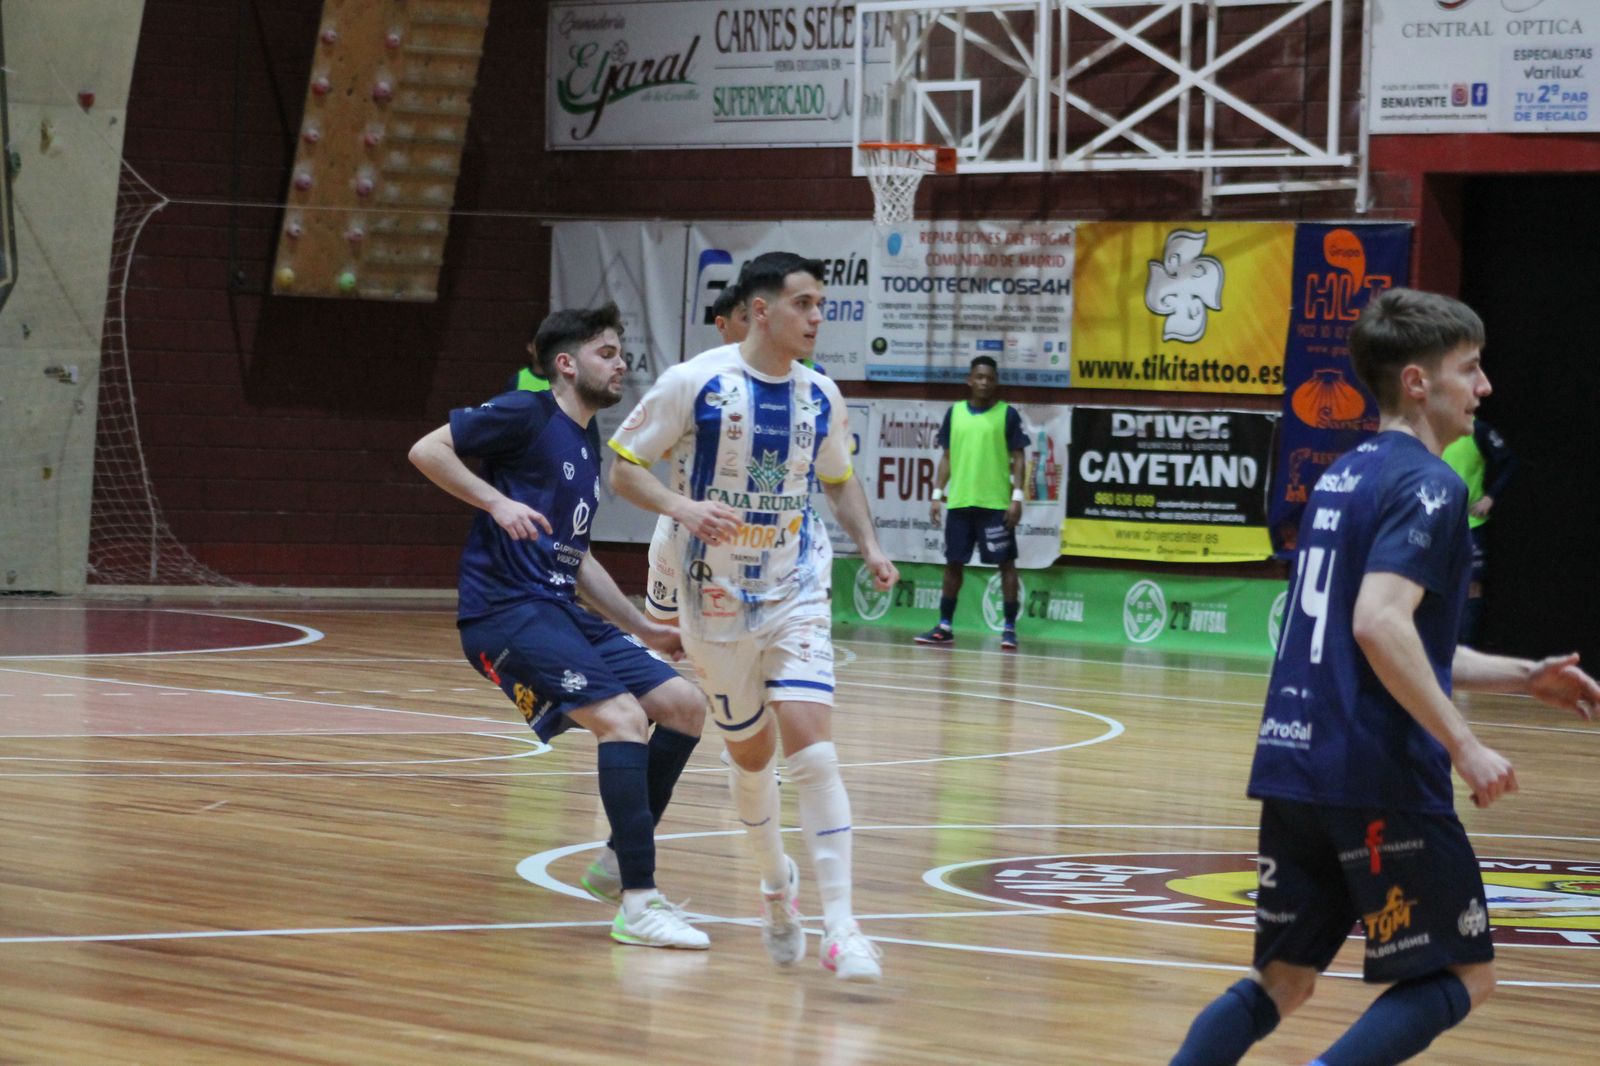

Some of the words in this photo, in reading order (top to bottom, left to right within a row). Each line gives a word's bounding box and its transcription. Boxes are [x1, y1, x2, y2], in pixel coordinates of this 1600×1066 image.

[714, 8, 797, 53] CARNES
[1401, 21, 1494, 38] CENTRAL
[1506, 19, 1583, 36] OPTICA
[1513, 48, 1593, 61] ESPECIALISTAS
[713, 84, 825, 117] SUPERMERCADO
[1381, 97, 1447, 108] BENAVENTE
[1517, 92, 1535, 104] TU
[1562, 92, 1589, 104] PAR
[1514, 112, 1532, 122] DE
[1536, 111, 1588, 122] REGALO
[925, 254, 997, 268] COMUNIDAD
[1000, 255, 1015, 268] DE
[1020, 255, 1066, 269] MADRID
[881, 275, 1071, 296] TODOTECNICOS24H
[1079, 353, 1284, 386] www.tikitattoo.es
[1079, 451, 1257, 489] CAYETANO
[707, 488, 752, 509] CAJA
[1115, 529, 1219, 544] www.drivercenter.es
[1190, 609, 1226, 633] FUTSAL
[714, 694, 733, 720] 7
